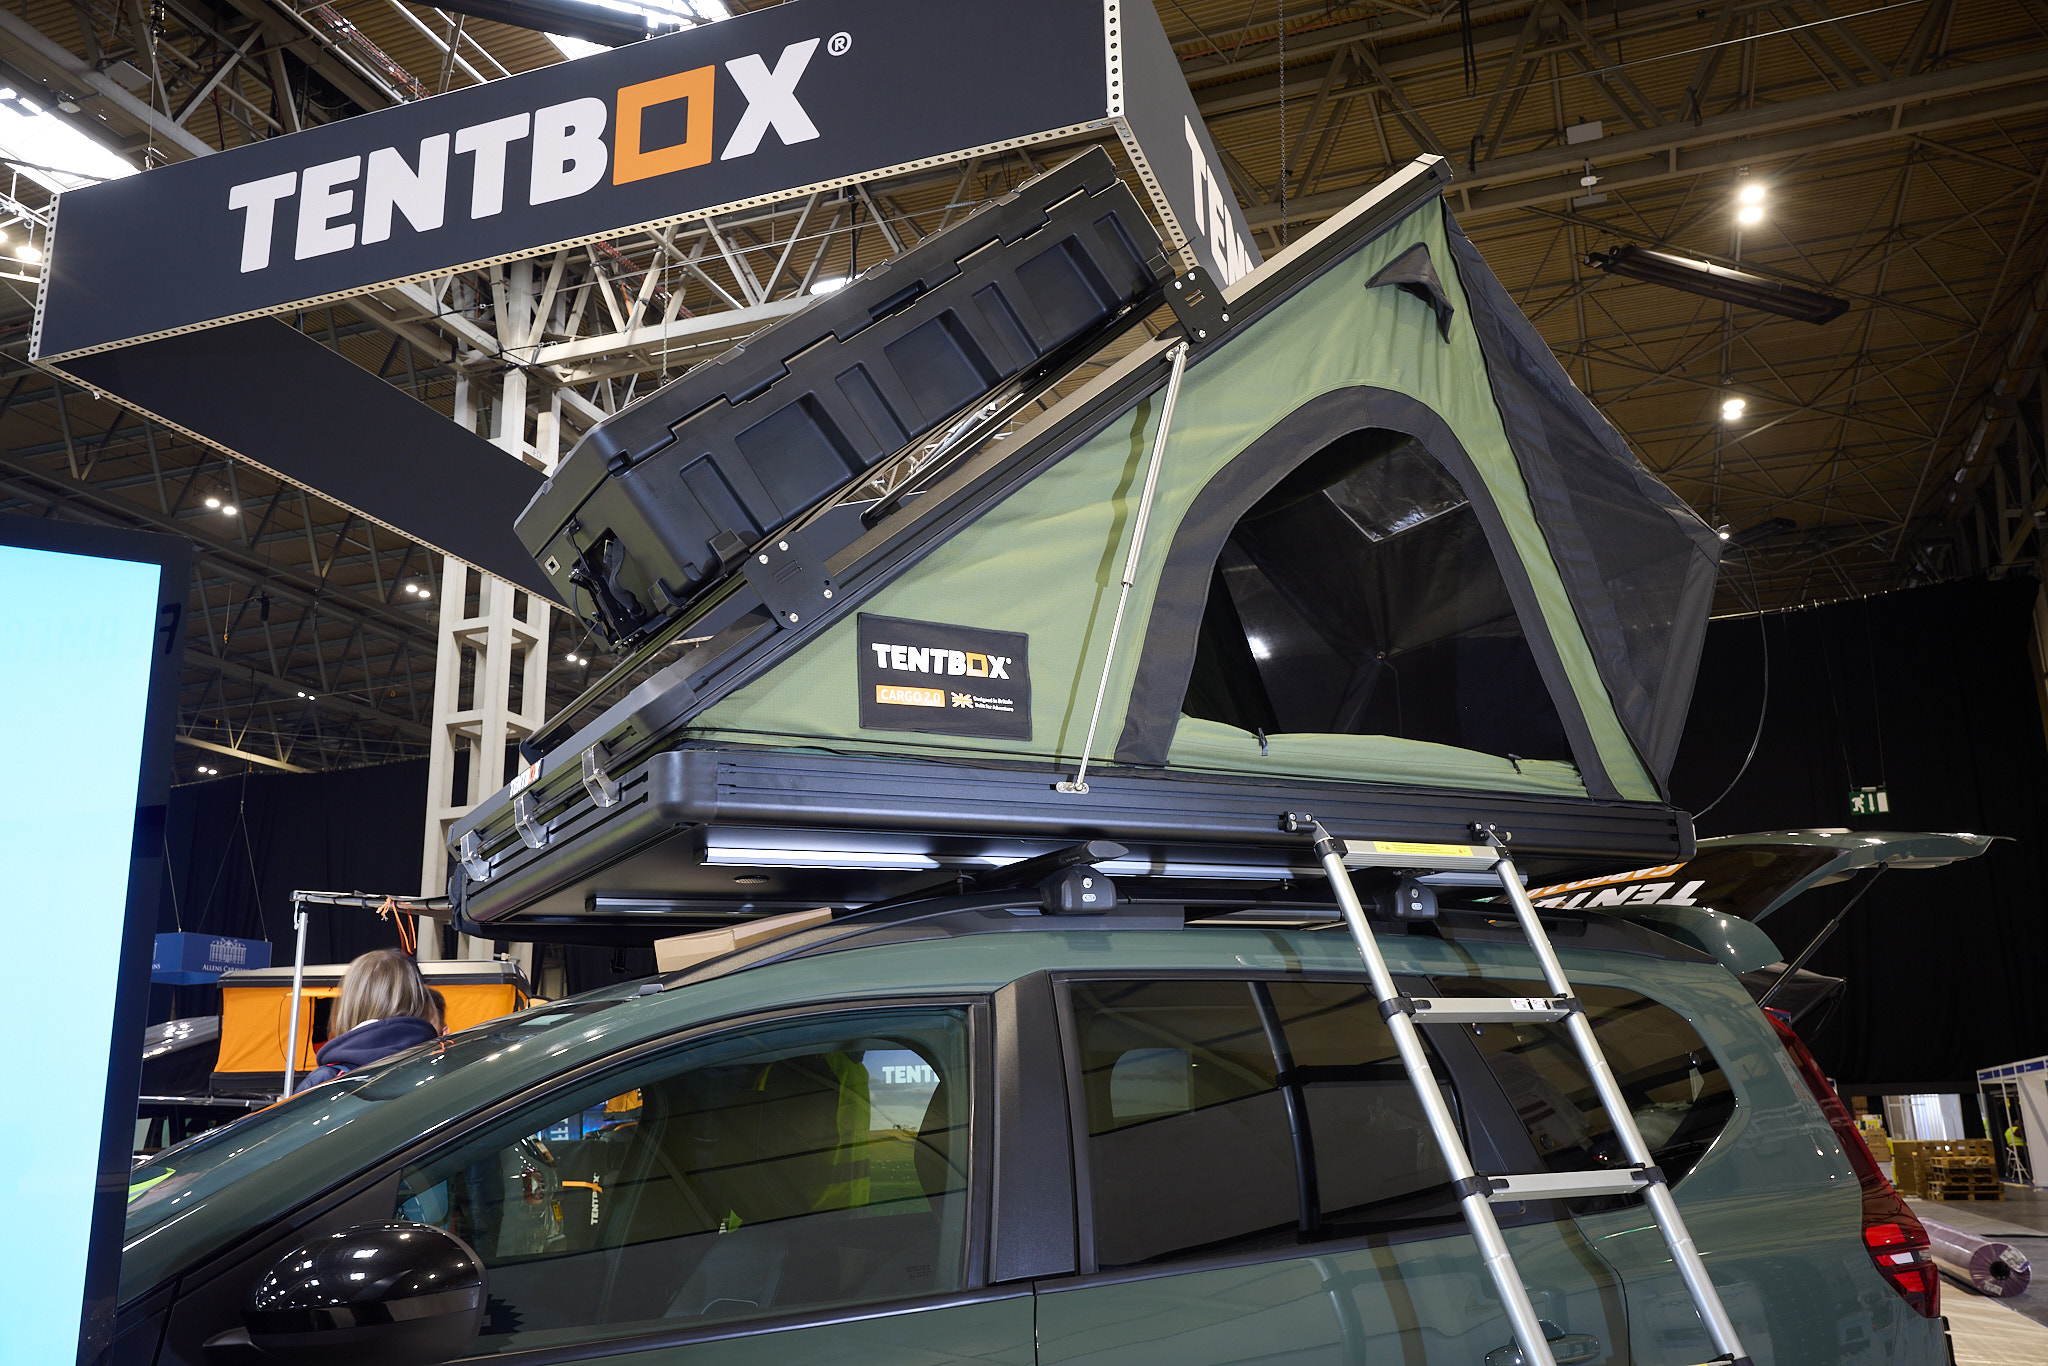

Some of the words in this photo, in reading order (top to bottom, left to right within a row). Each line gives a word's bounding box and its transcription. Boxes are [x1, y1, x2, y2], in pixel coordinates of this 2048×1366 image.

[881, 689, 922, 702] CARGO
[924, 691, 941, 703] 2.0
[202, 963, 222, 972] ALLENS
